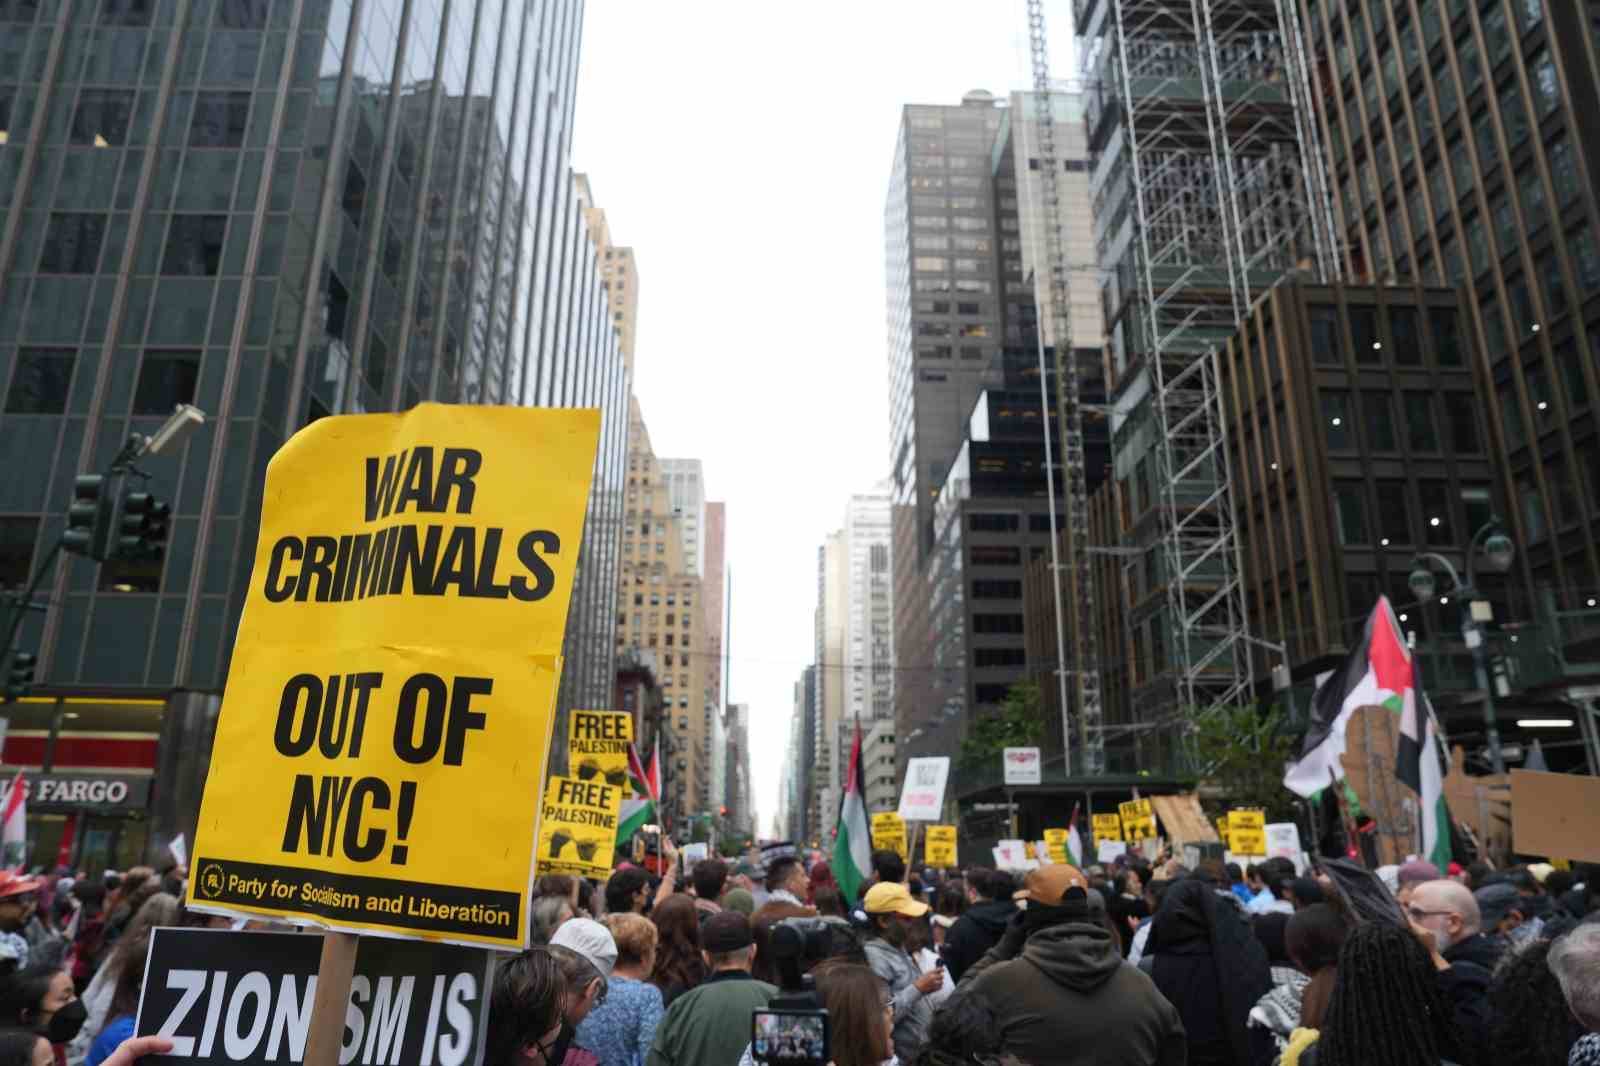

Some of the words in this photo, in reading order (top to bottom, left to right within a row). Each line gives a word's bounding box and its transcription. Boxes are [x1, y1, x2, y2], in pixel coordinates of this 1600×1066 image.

[365, 446, 482, 522] WAR
[264, 524, 561, 603] CRIMINALS
[274, 672, 384, 760] OUT
[392, 676, 494, 767] OF
[574, 713, 628, 740] FREE
[570, 739, 629, 754] PALESTIN
[36, 780, 128, 803] FARGO
[544, 805, 616, 830] PALESTINE
[557, 780, 613, 810] FREE
[281, 774, 418, 866] NYC!
[228, 874, 267, 899] Party
[271, 879, 297, 899] for
[301, 882, 360, 910] Socialism
[365, 894, 404, 914] and
[408, 896, 511, 926] Liberation
[157, 969, 416, 1066] ZIONSM
[419, 971, 478, 1066] IS
